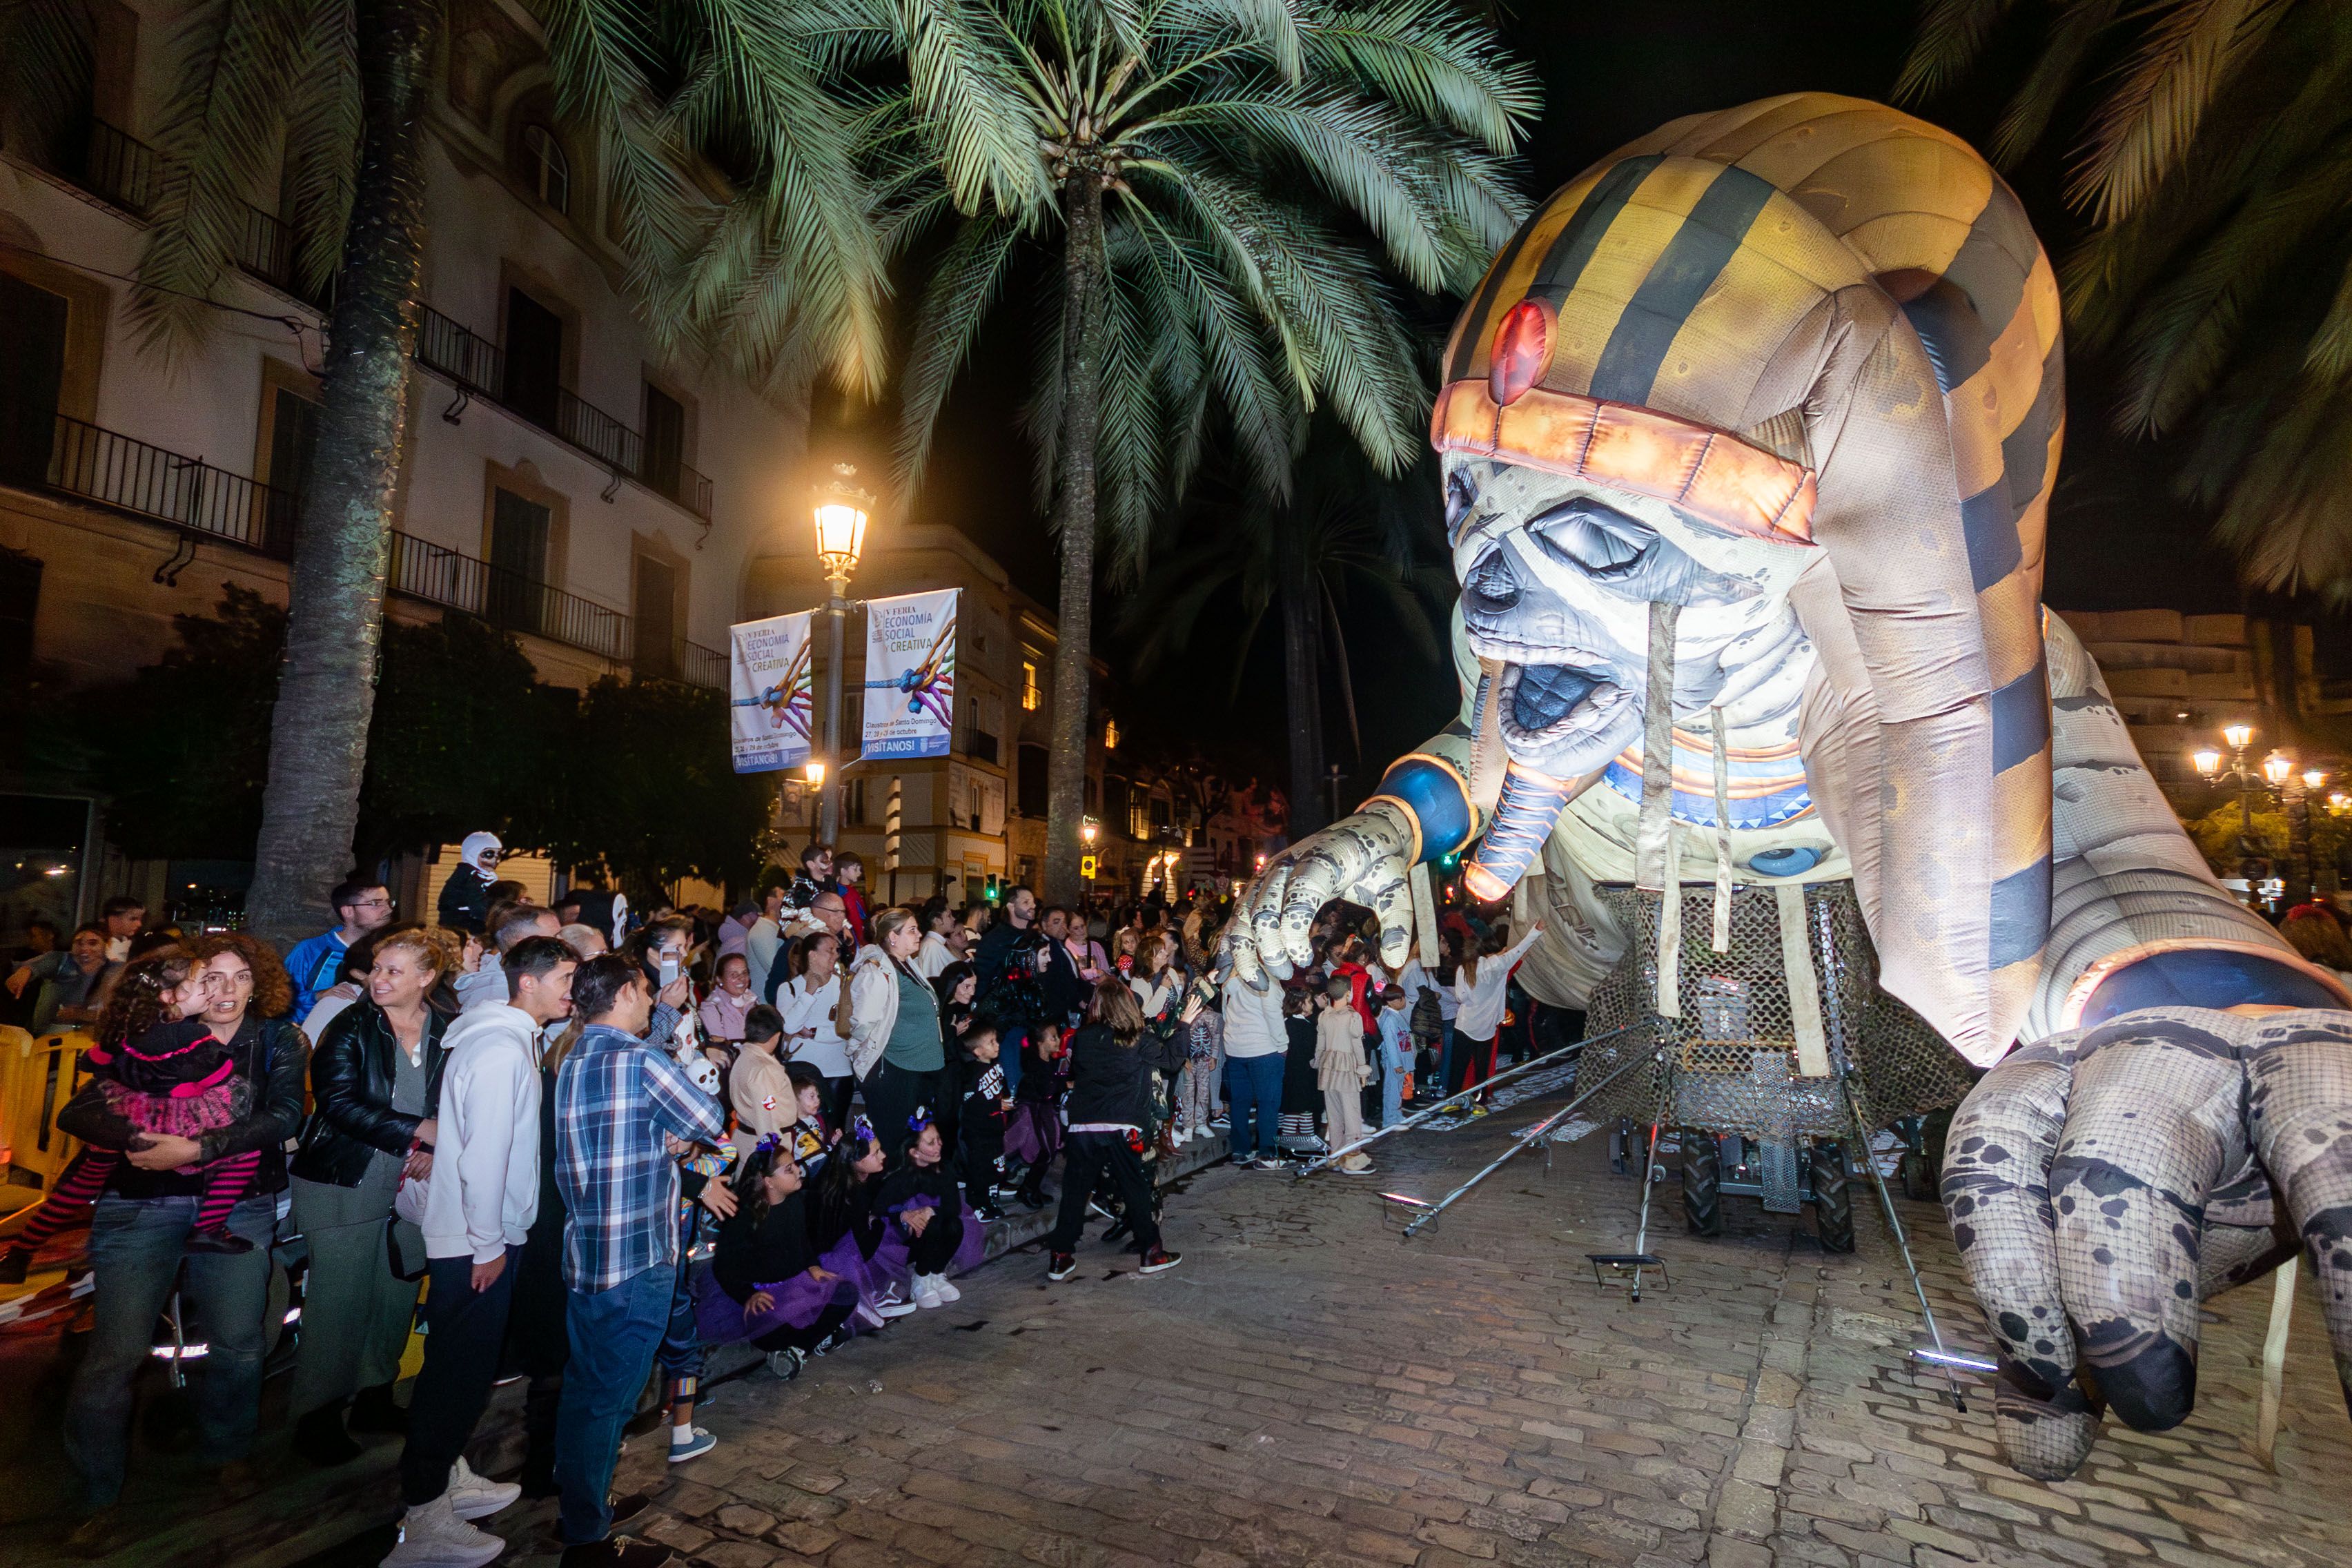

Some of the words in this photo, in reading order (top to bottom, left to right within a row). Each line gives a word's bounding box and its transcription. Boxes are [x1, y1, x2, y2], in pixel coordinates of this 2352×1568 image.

[892, 606, 916, 616] FERIA
[884, 627, 915, 640] SOCIAL
[890, 638, 933, 653] CREATIVA
[747, 648, 774, 663] SOCIAL
[752, 657, 790, 673] CREATIVA
